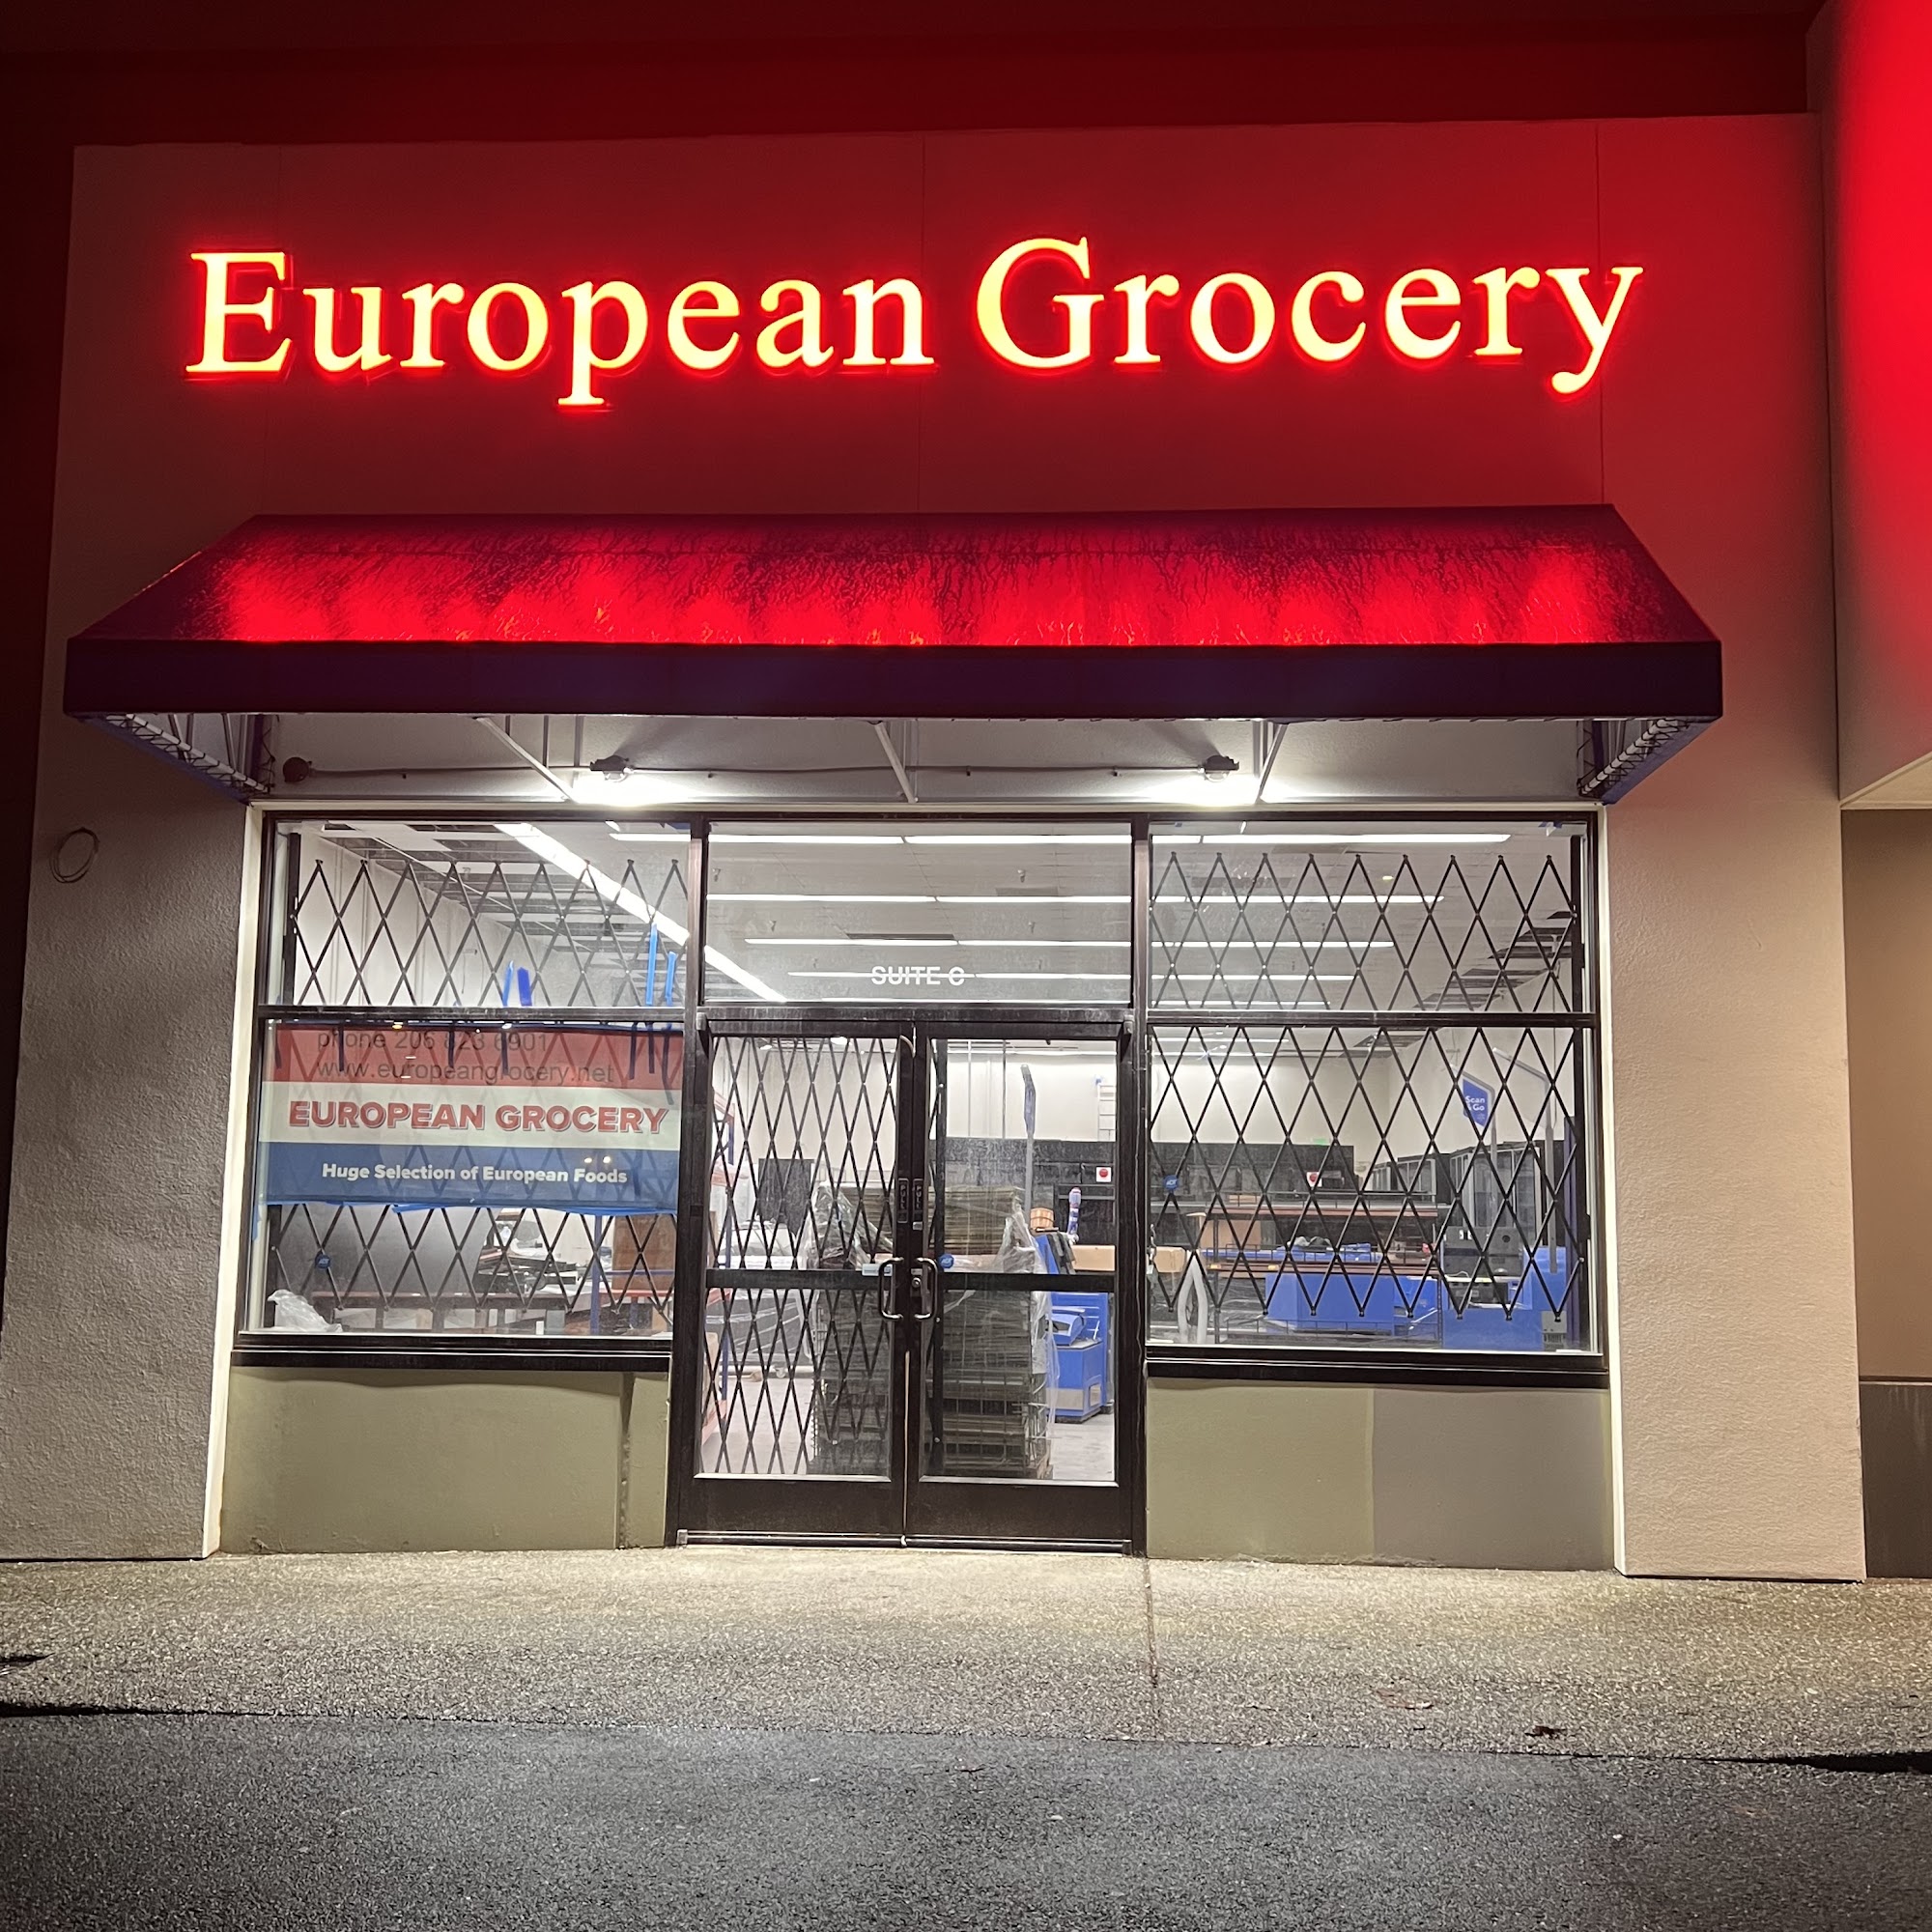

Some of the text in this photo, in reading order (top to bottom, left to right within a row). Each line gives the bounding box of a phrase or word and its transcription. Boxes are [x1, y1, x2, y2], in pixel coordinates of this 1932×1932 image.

[185, 236, 1644, 406] European Grocery
[870, 966, 941, 985] SUITE
[395, 1030, 435, 1050] 206
[289, 1100, 668, 1134] EUROPEAN GROCERY
[322, 1163, 628, 1184] Huge Selection of European Foods
